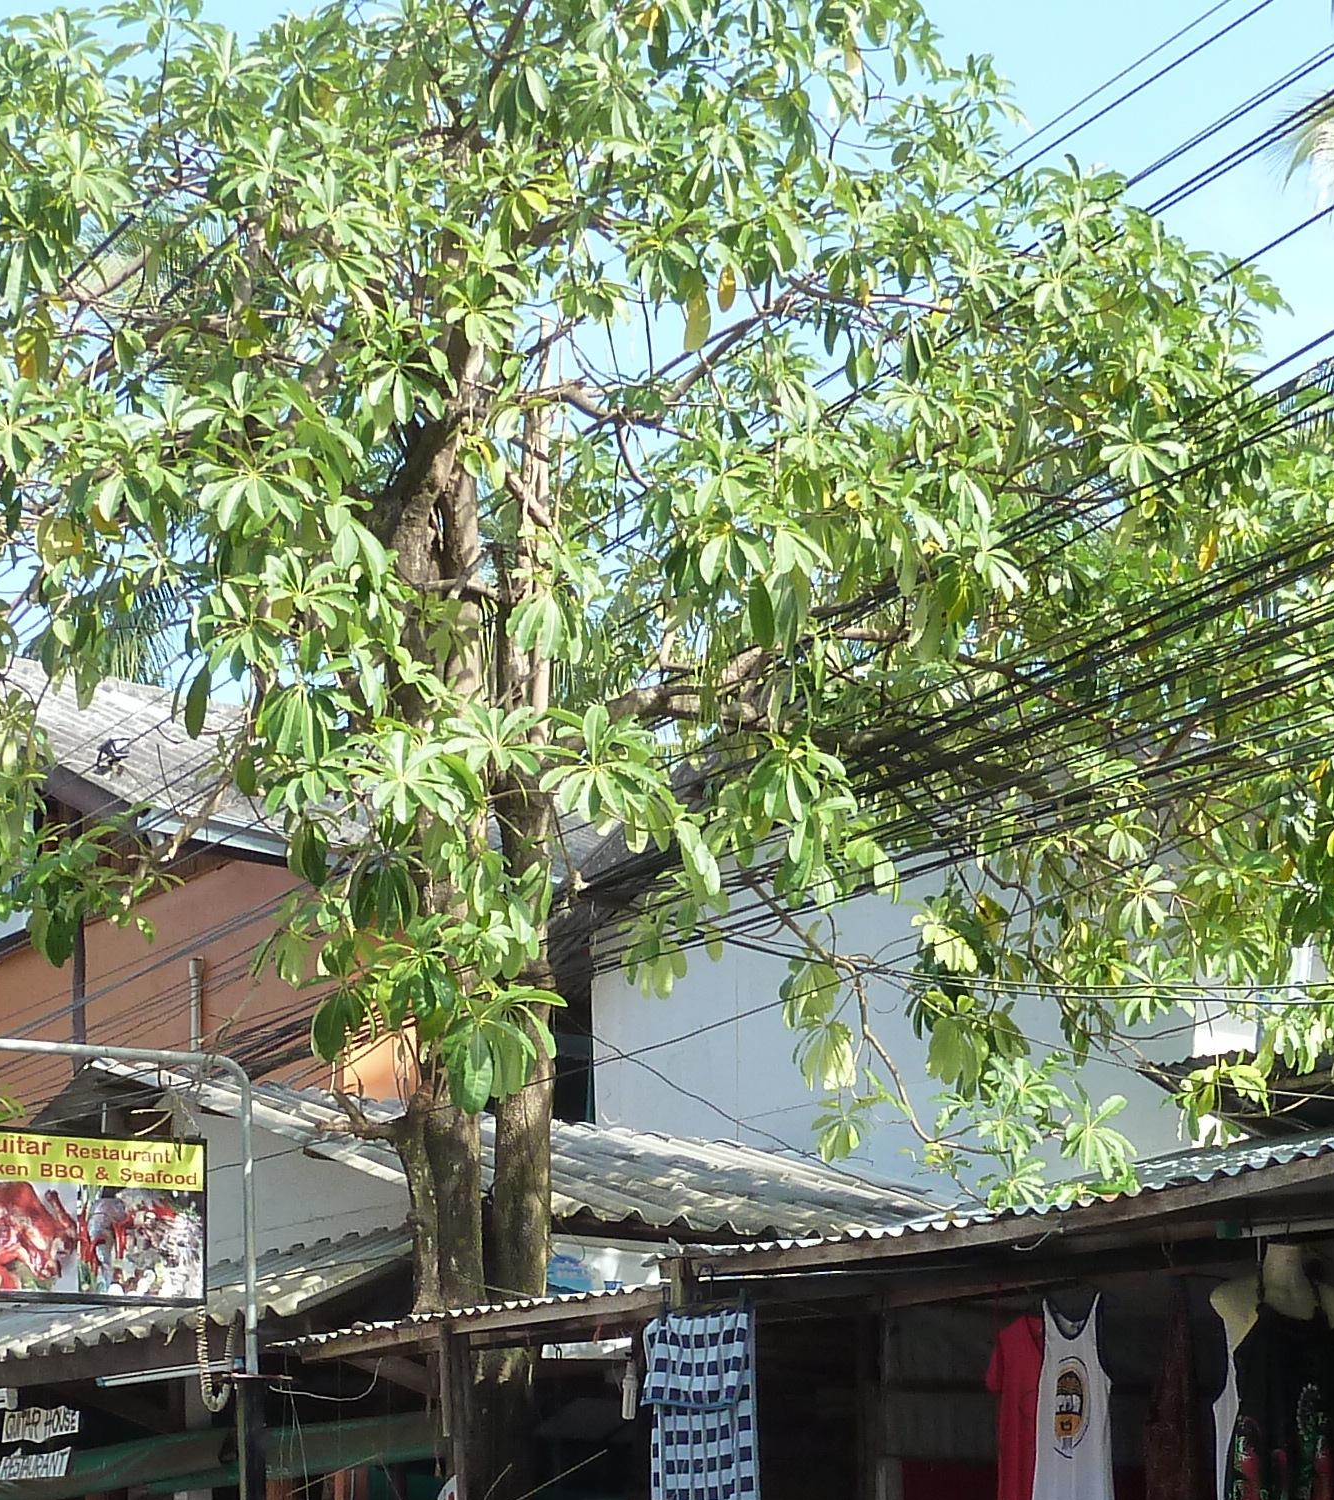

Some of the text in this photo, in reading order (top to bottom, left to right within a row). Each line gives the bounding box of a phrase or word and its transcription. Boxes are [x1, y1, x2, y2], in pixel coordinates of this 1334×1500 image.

[66, 1143, 172, 1164] Restaurant
[40, 1163, 85, 1180] BBQ
[95, 1167, 109, 1181] &
[120, 1168, 198, 1186] Seafood
[44, 1407, 78, 1437] HOUSE
